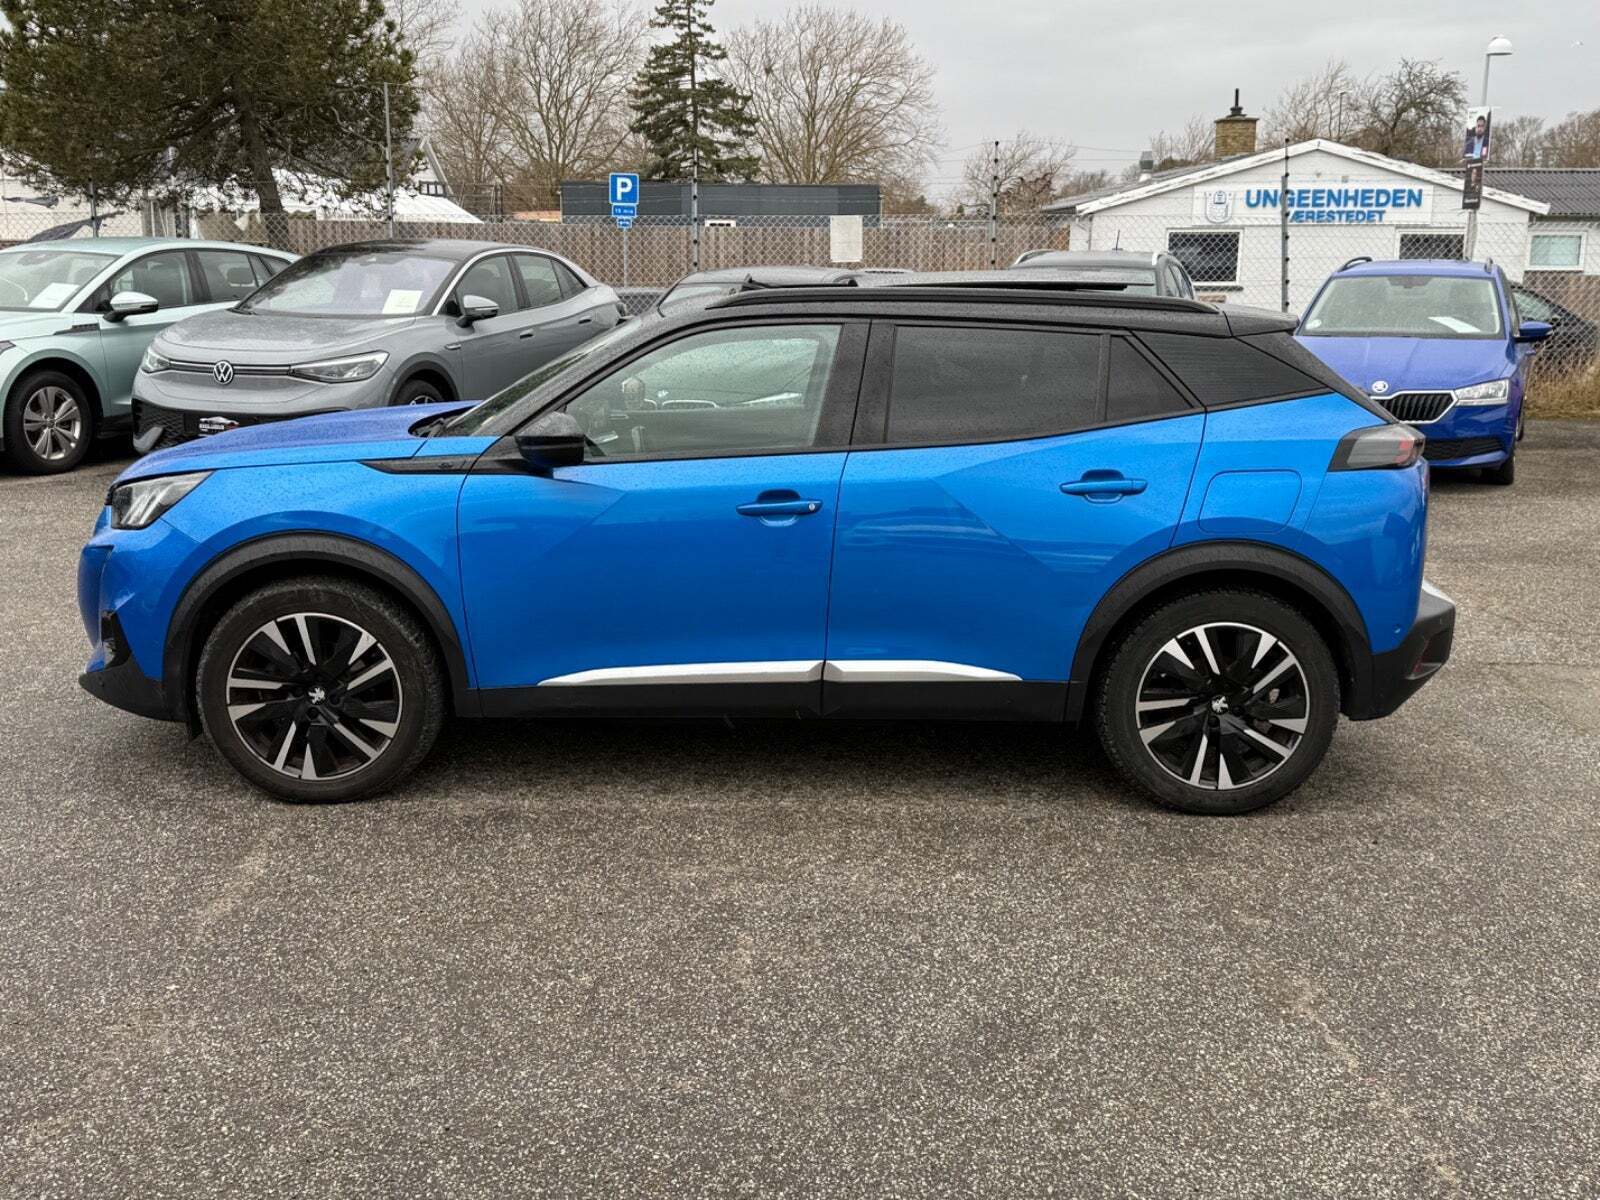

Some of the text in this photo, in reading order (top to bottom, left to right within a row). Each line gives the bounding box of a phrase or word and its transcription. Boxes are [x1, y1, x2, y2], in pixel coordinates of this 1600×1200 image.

[616, 177, 632, 201] P
[1246, 189, 1423, 208] UNGEENHEDEN
[1282, 210, 1386, 223] ÆRESTEDET
